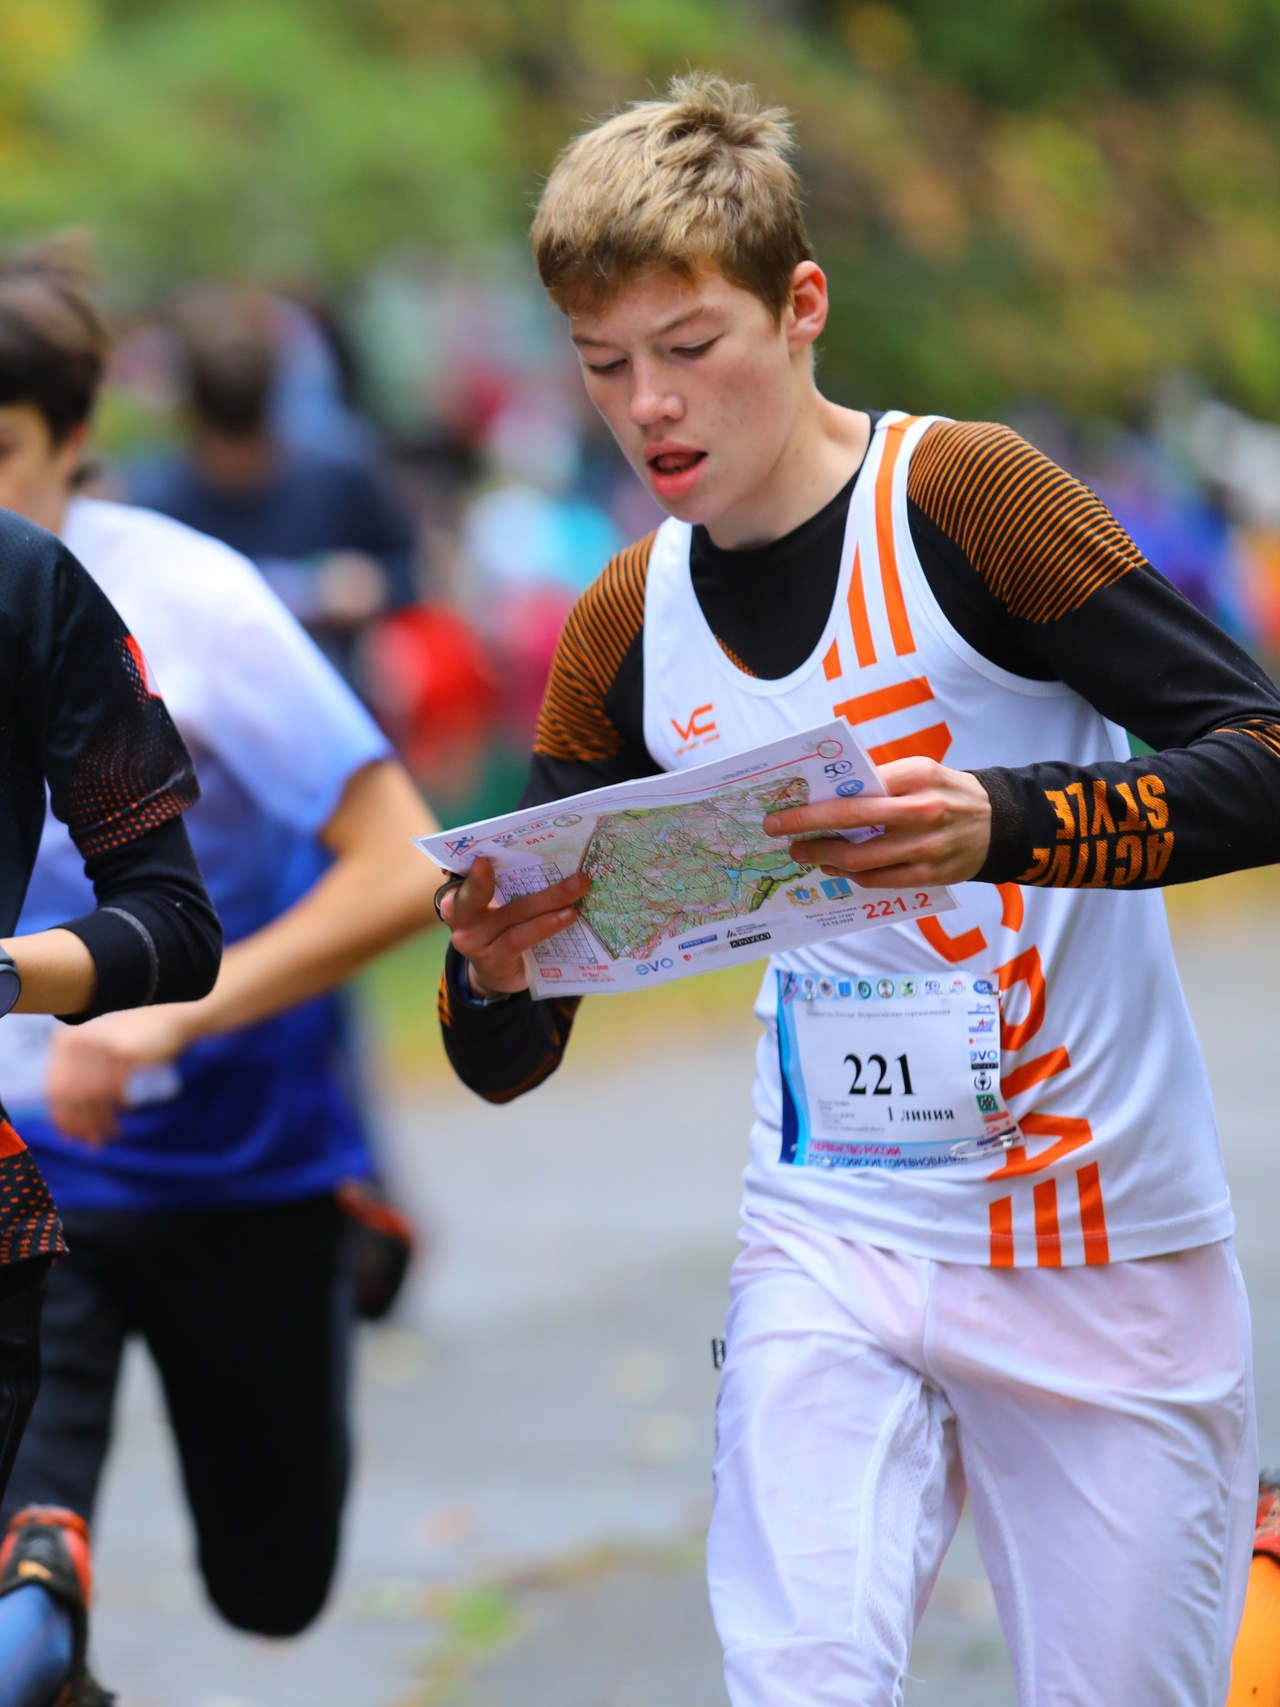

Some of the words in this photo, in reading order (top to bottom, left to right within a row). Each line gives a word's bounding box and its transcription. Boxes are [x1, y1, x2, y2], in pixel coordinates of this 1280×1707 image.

[1044, 774, 1169, 839] STYLE
[862, 892, 933, 919] 221.2
[636, 957, 674, 976] evo
[843, 1053, 918, 1096] 221
[901, 1107, 956, 1122] линия
